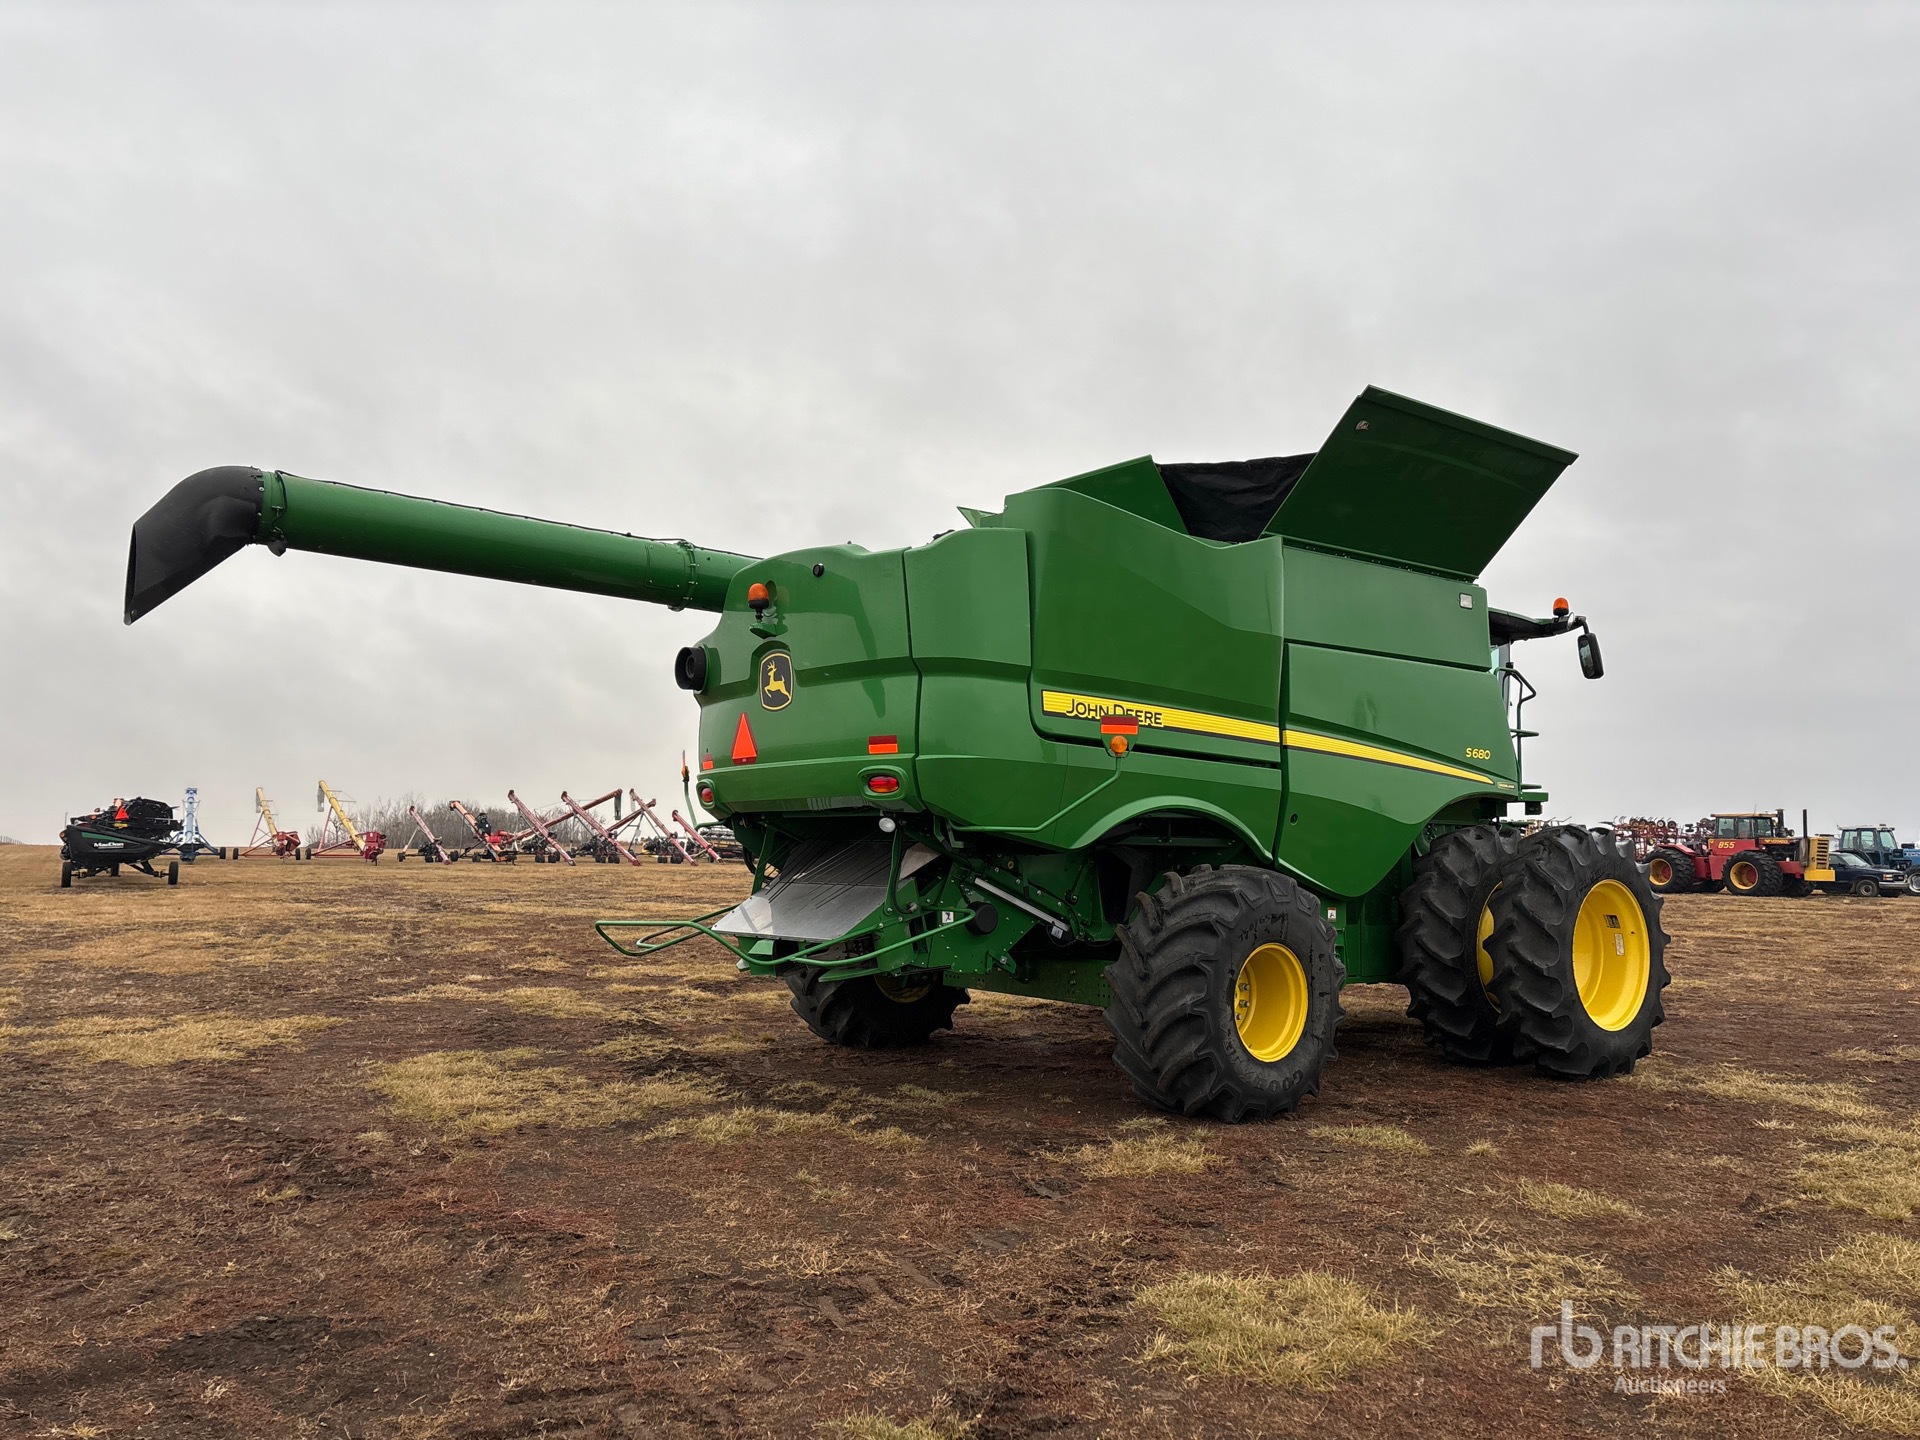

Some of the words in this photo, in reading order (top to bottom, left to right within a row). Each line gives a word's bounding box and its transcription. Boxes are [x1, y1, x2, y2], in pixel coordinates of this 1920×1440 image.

[1066, 698, 1109, 720] JOHN
[1465, 747, 1491, 760] S680
[1718, 841, 1735, 849] 855
